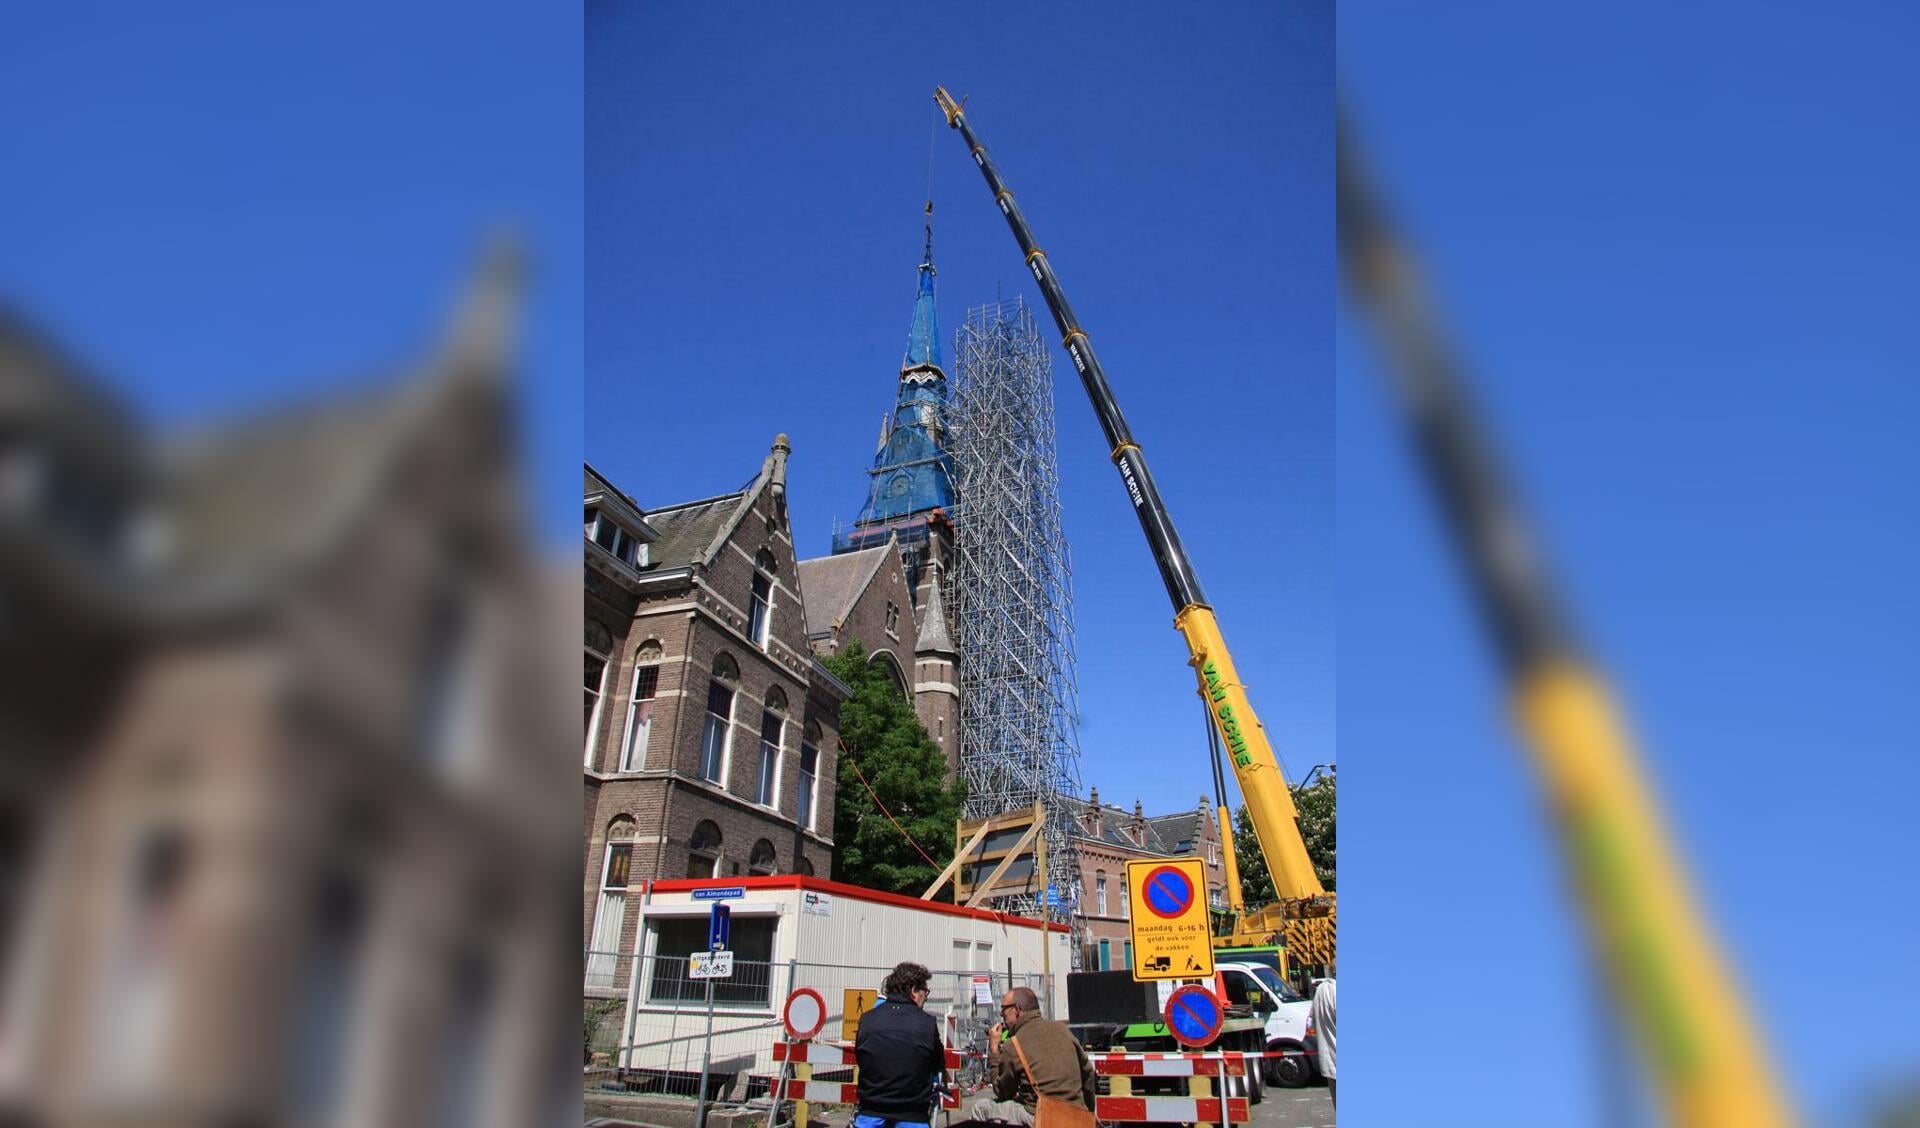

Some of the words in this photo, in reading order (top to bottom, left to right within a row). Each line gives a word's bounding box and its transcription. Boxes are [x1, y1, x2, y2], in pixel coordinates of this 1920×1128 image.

[1119, 456, 1132, 479] VAN
[1127, 476, 1144, 508] SCHIE
[1203, 661, 1226, 703] VAN
[1218, 703, 1253, 769] SCHIE
[1137, 925, 1173, 933] maandag
[1199, 923, 1206, 931] h
[1147, 935, 1165, 943] geldt
[1166, 944, 1189, 952] vakken
